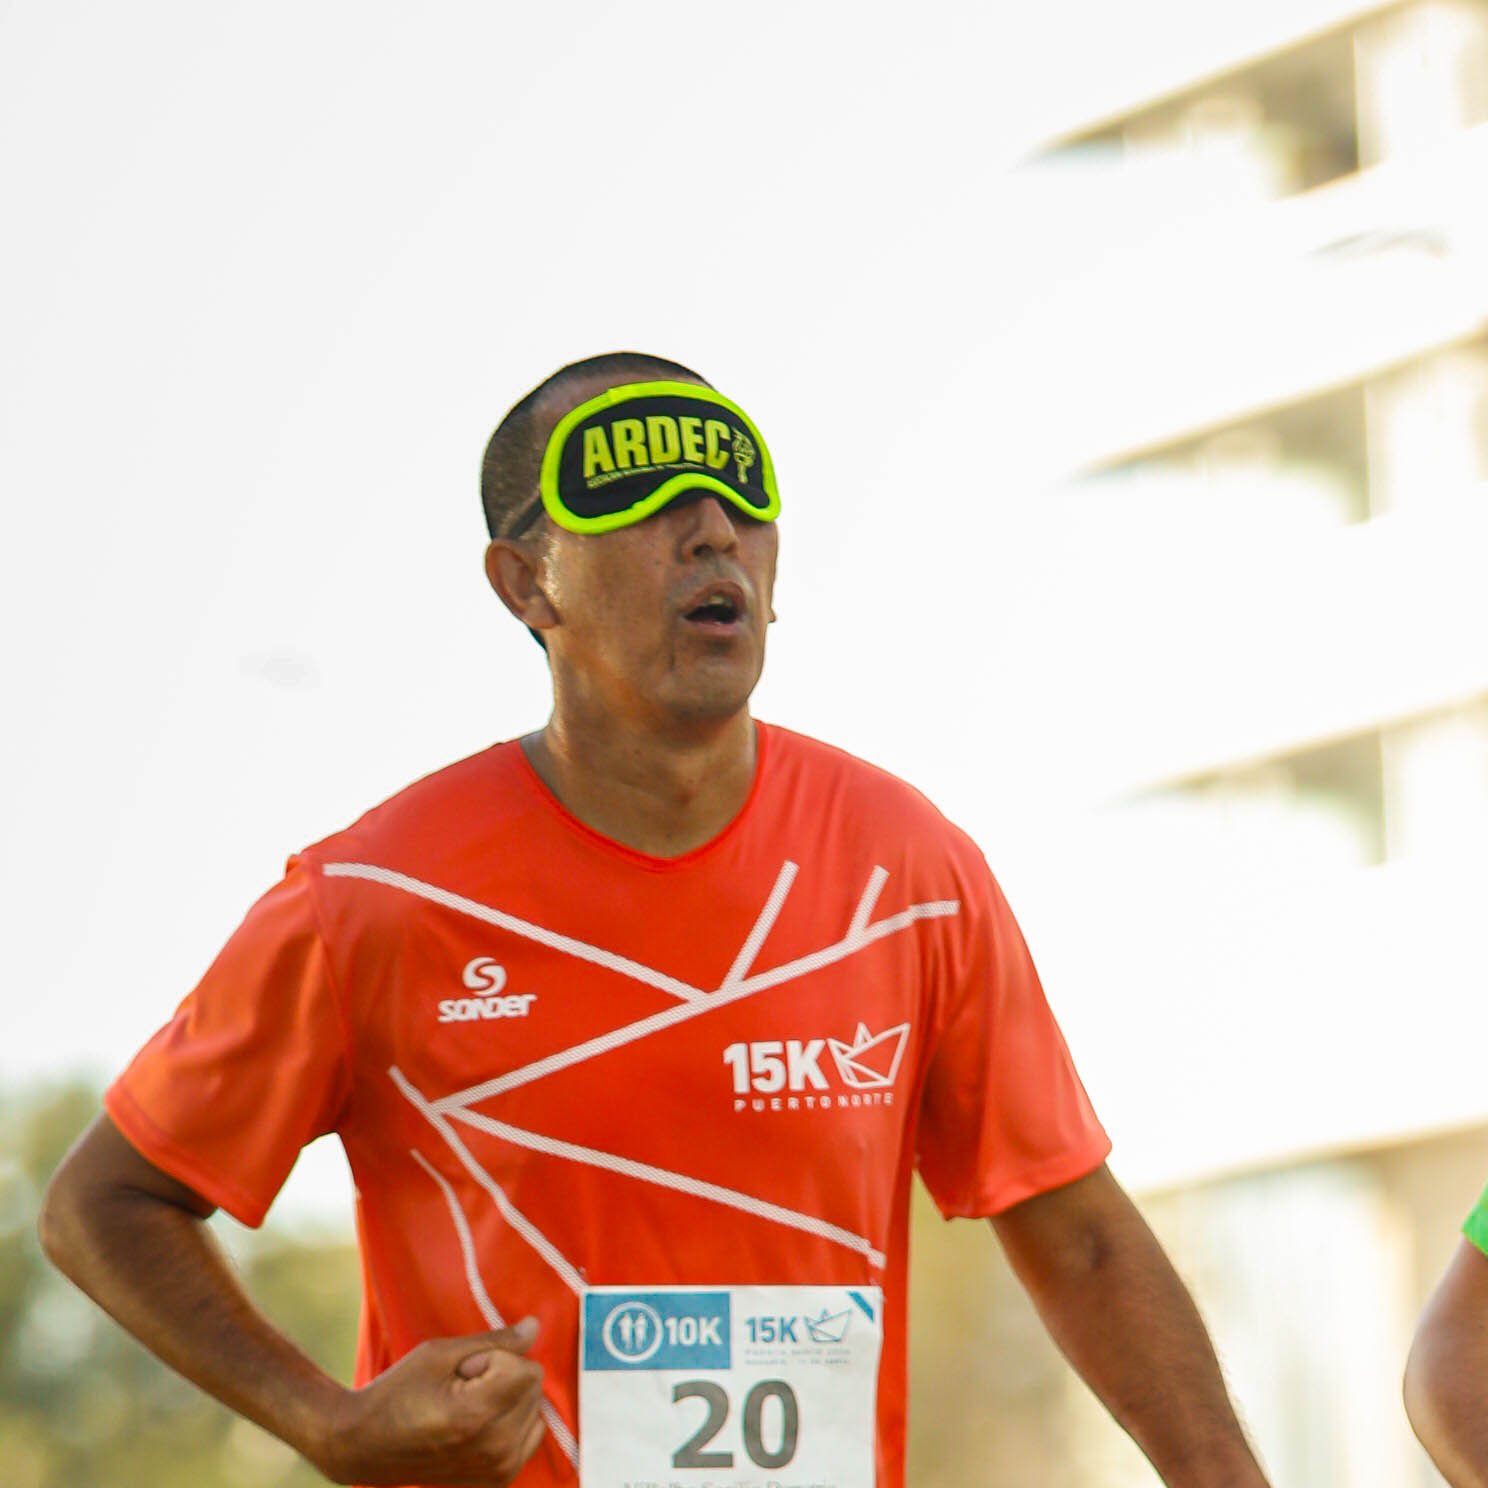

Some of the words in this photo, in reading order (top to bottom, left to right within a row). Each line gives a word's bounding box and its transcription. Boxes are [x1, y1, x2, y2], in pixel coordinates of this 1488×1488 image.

[582, 415, 731, 479] ARDEC
[723, 1038, 830, 1095] 15K
[734, 1095, 832, 1112] PUERTO
[838, 1091, 894, 1108] NORTE
[664, 1315, 722, 1347] 10K
[745, 1315, 798, 1343] 15K
[671, 1378, 799, 1469] 20
